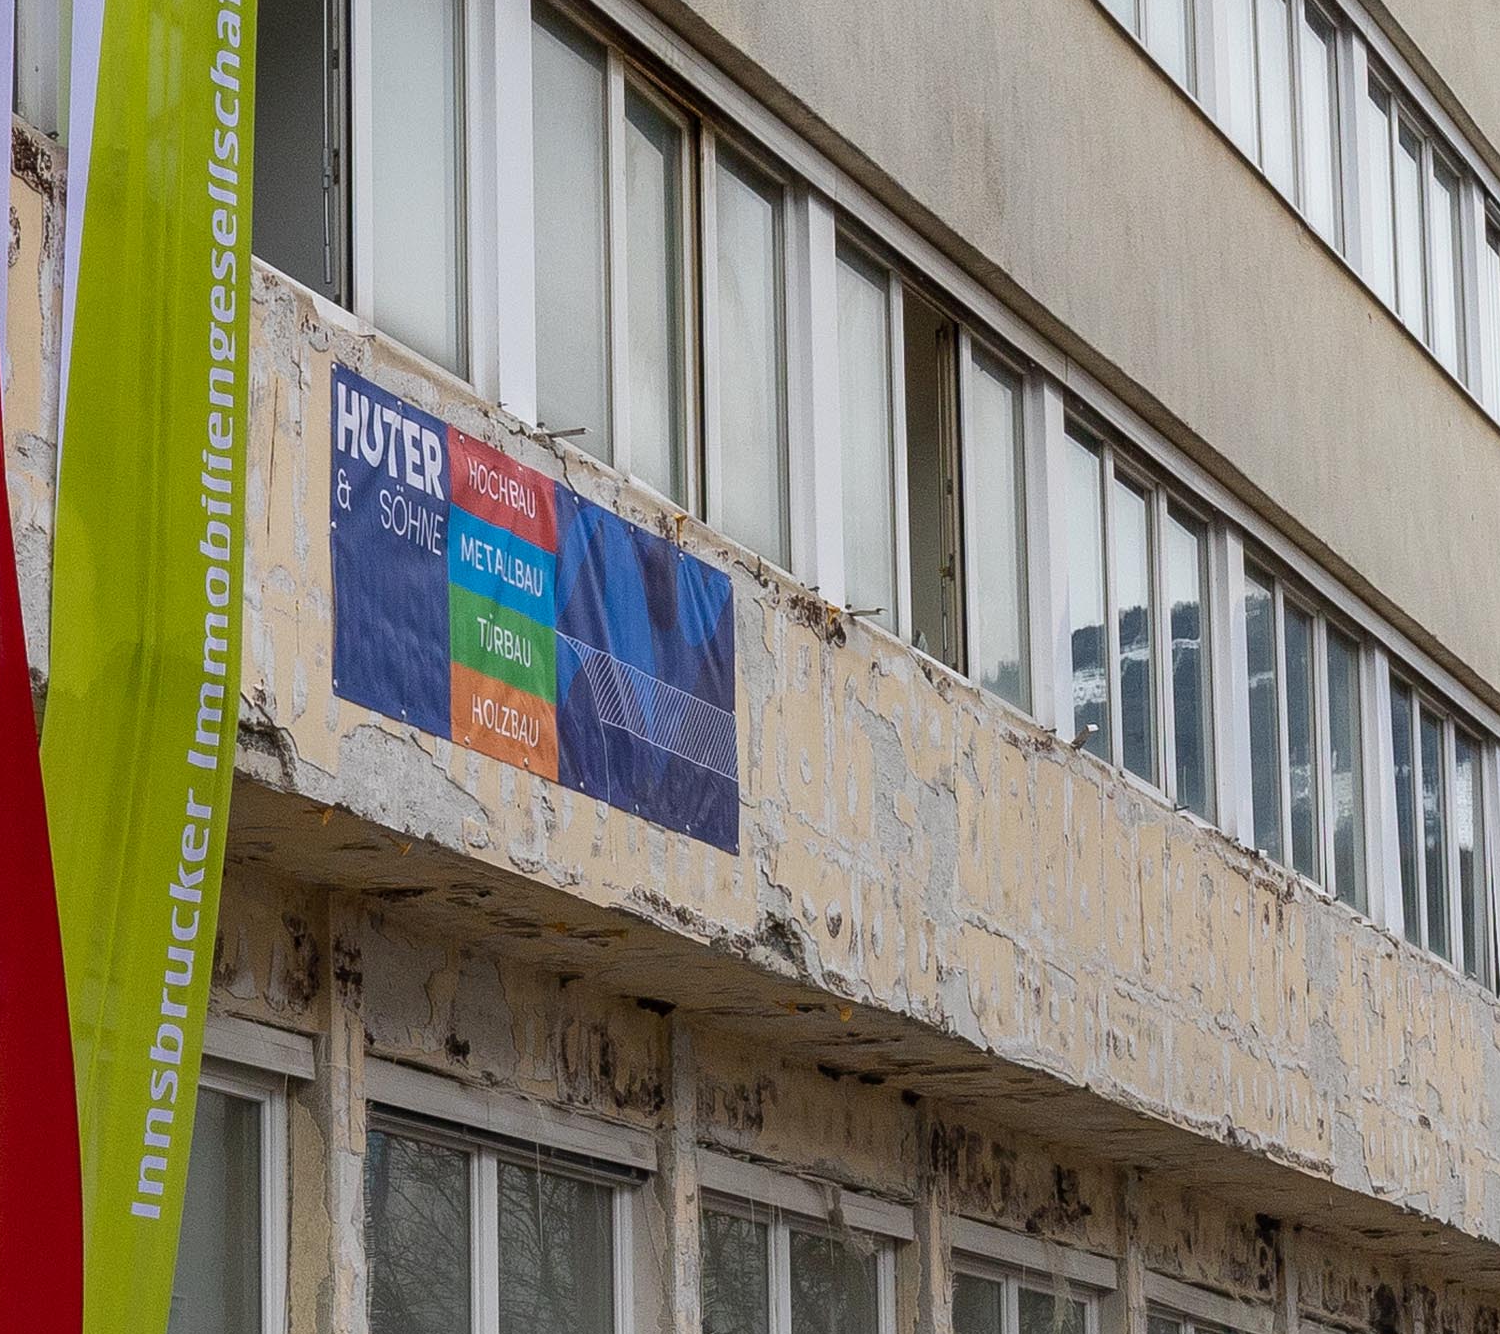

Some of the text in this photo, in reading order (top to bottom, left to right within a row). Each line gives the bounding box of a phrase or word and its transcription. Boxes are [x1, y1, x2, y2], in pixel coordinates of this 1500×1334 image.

[337, 382, 445, 501] HUTER
[337, 468, 445, 556] & SÖHNE
[467, 457, 537, 519] HOCHBAU
[461, 533, 544, 598] METALLBAU
[477, 614, 533, 668] TÜRBAU
[472, 694, 540, 748] HOLZBAU
[130, 787, 213, 1220] Innsbrucker
